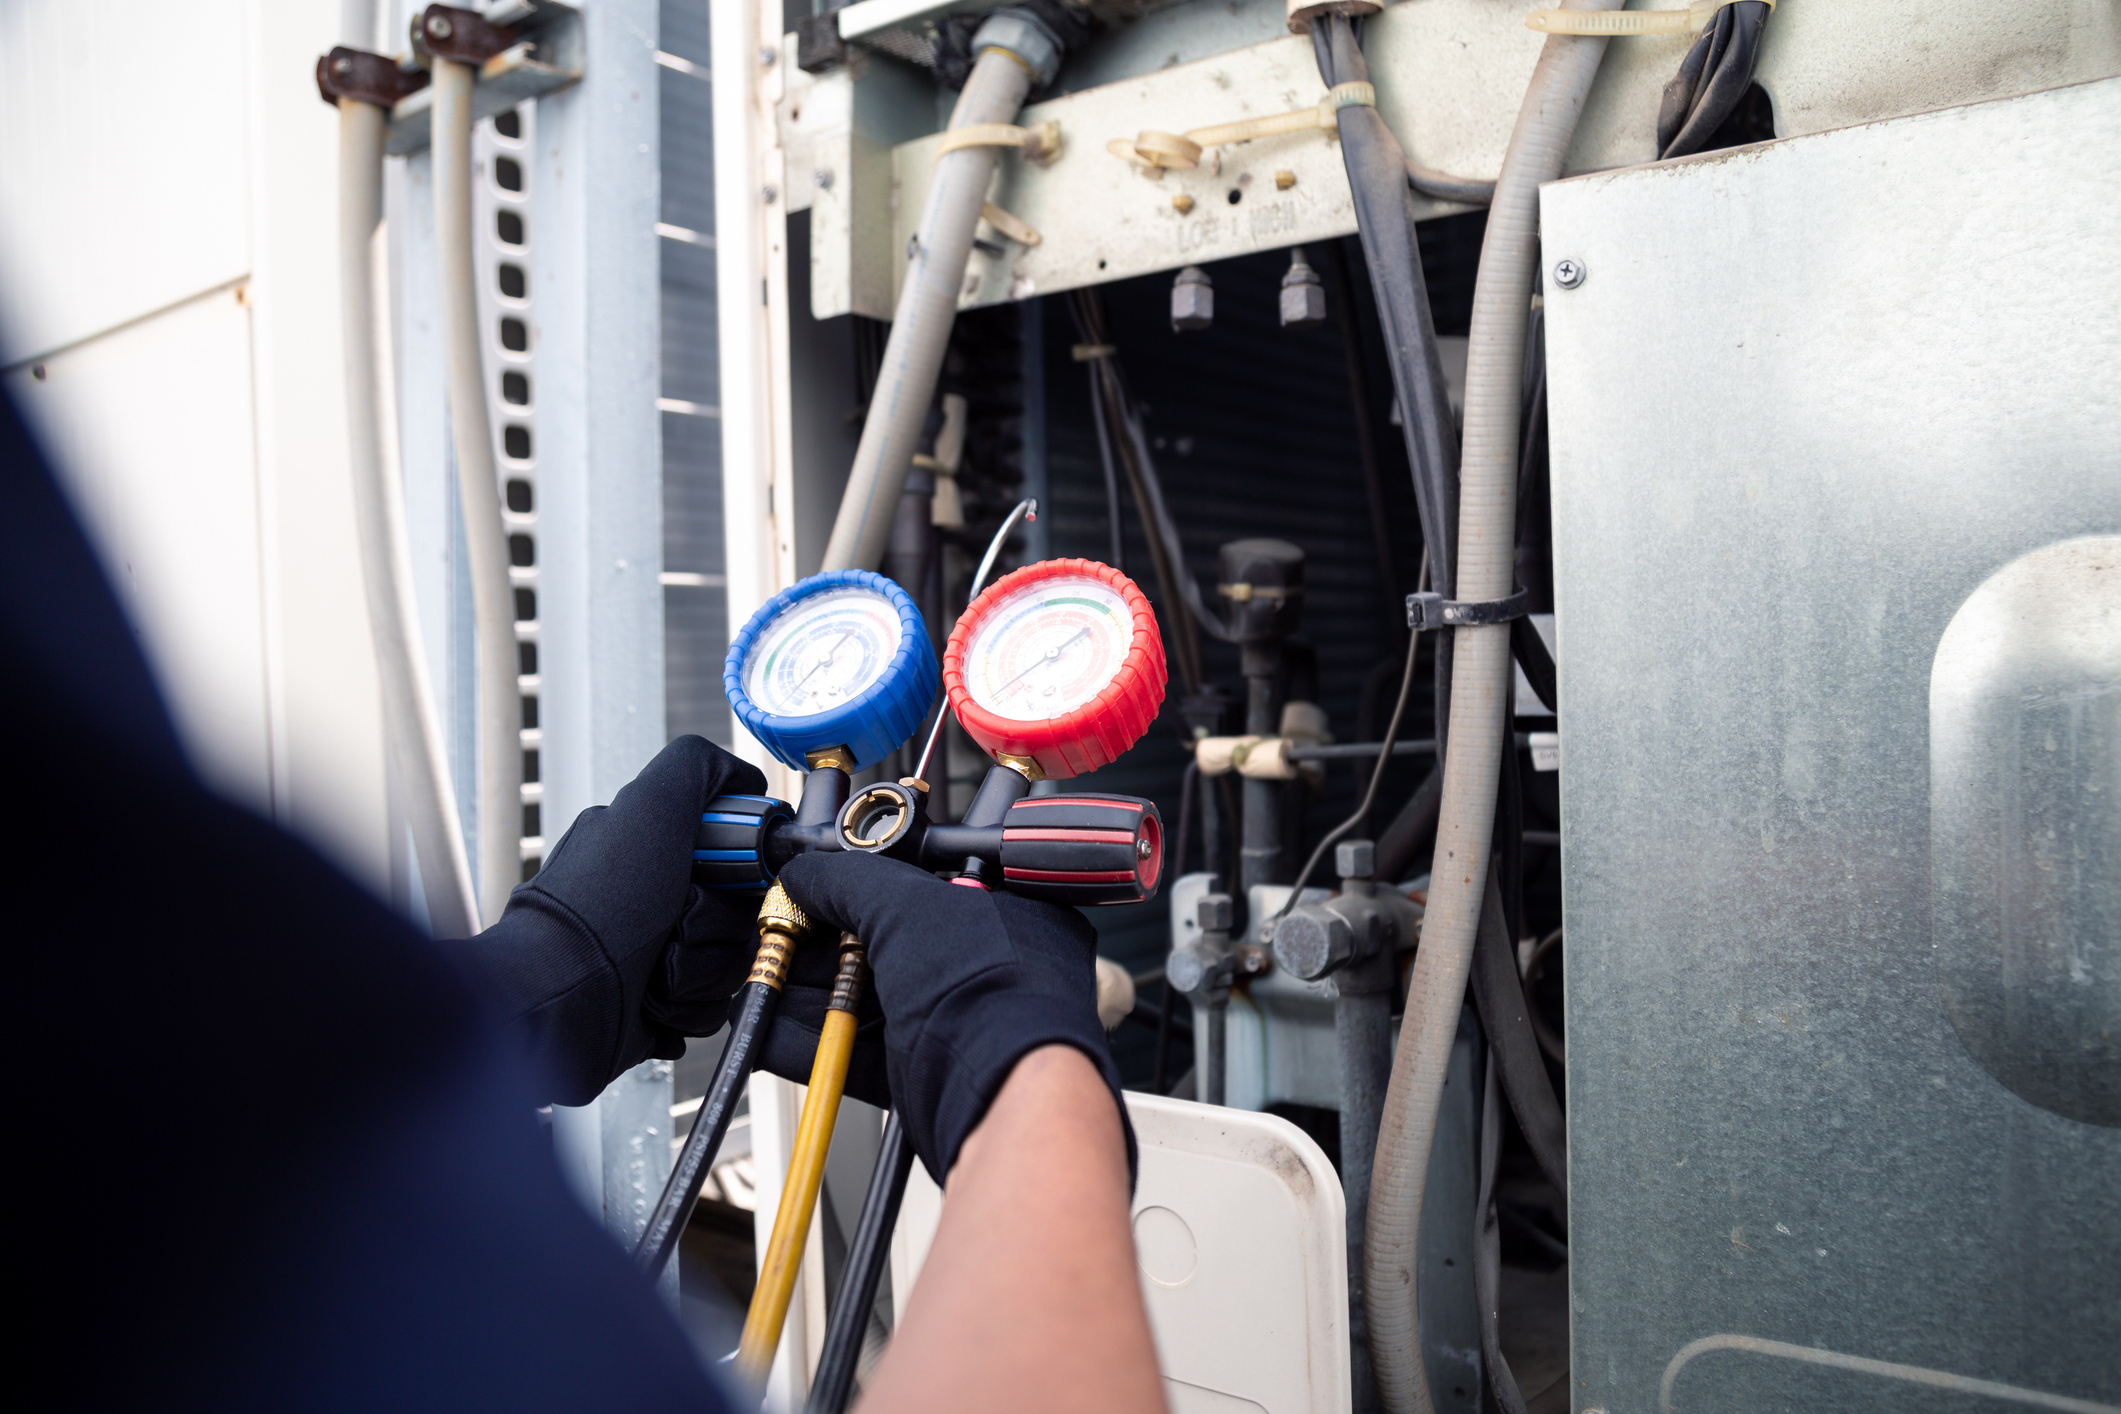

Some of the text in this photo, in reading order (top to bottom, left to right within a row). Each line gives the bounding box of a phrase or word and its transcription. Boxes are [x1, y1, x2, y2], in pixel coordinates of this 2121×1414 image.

[747, 997, 766, 1024] BAR
[726, 1032, 753, 1079] BURST
[706, 1102, 724, 1126] 800
[669, 1176, 691, 1208] BAR
